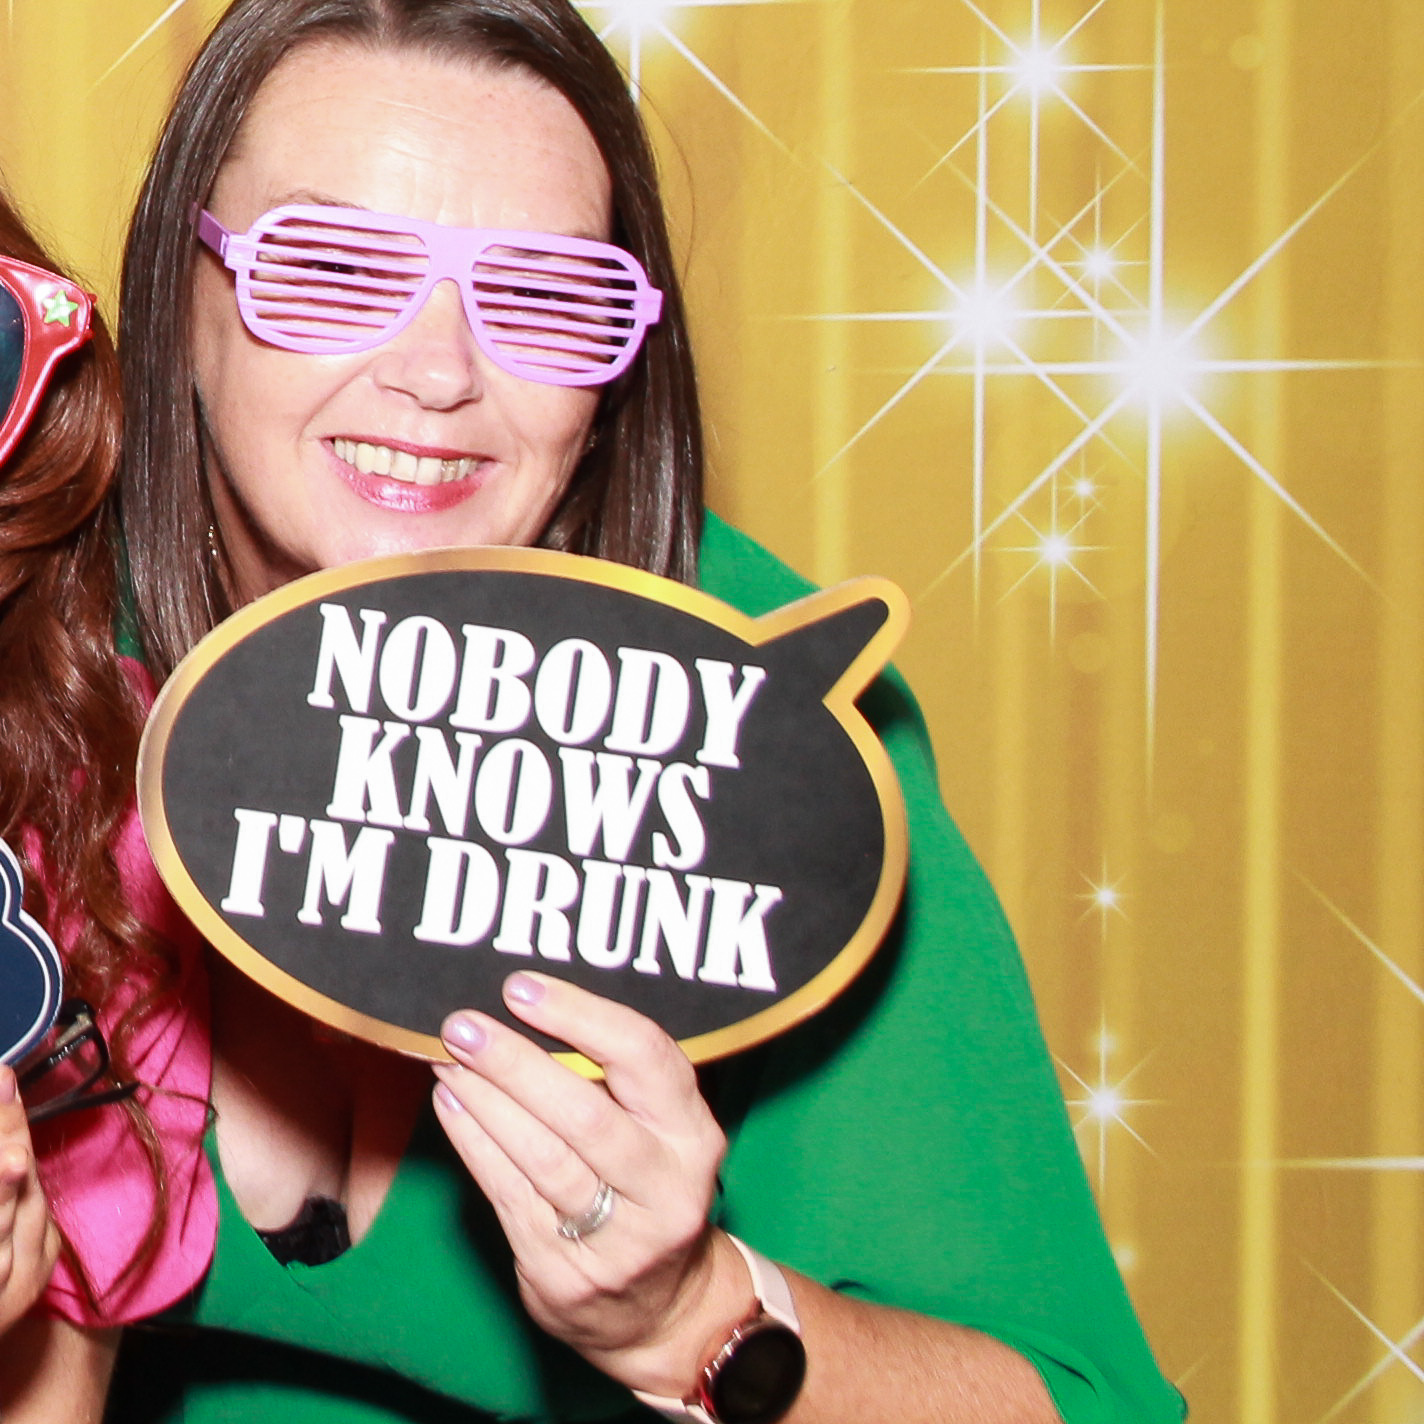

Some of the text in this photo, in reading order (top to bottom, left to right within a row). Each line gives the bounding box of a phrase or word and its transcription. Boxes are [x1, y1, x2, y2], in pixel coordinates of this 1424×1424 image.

[307, 603, 767, 769] NOBODY
[326, 714, 712, 871] KNOWS
[220, 808, 784, 993] I'M DRUNK
